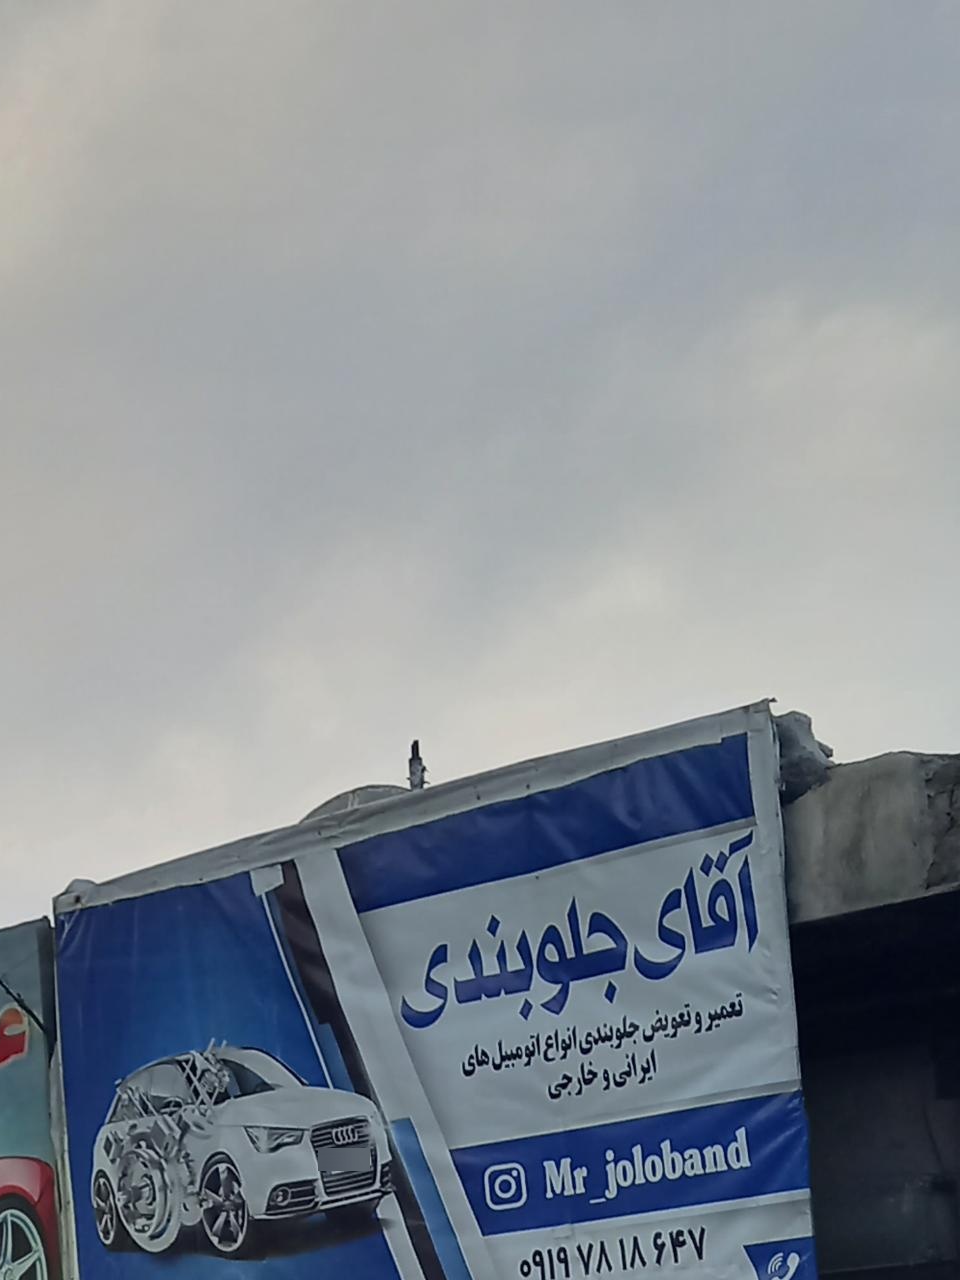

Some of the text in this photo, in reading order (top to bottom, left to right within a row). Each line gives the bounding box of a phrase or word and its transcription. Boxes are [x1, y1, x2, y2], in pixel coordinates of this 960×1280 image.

[400, 830, 760, 1030] آقای جلوبندی
[642, 1002, 692, 1043] تعویض
[694, 1008, 704, 1034] و
[705, 993, 744, 1032] تعمیر
[542, 1025, 578, 1064] انواع
[579, 1018, 640, 1058] جلوبندی
[547, 1050, 658, 1100] ایرانی و خارجی
